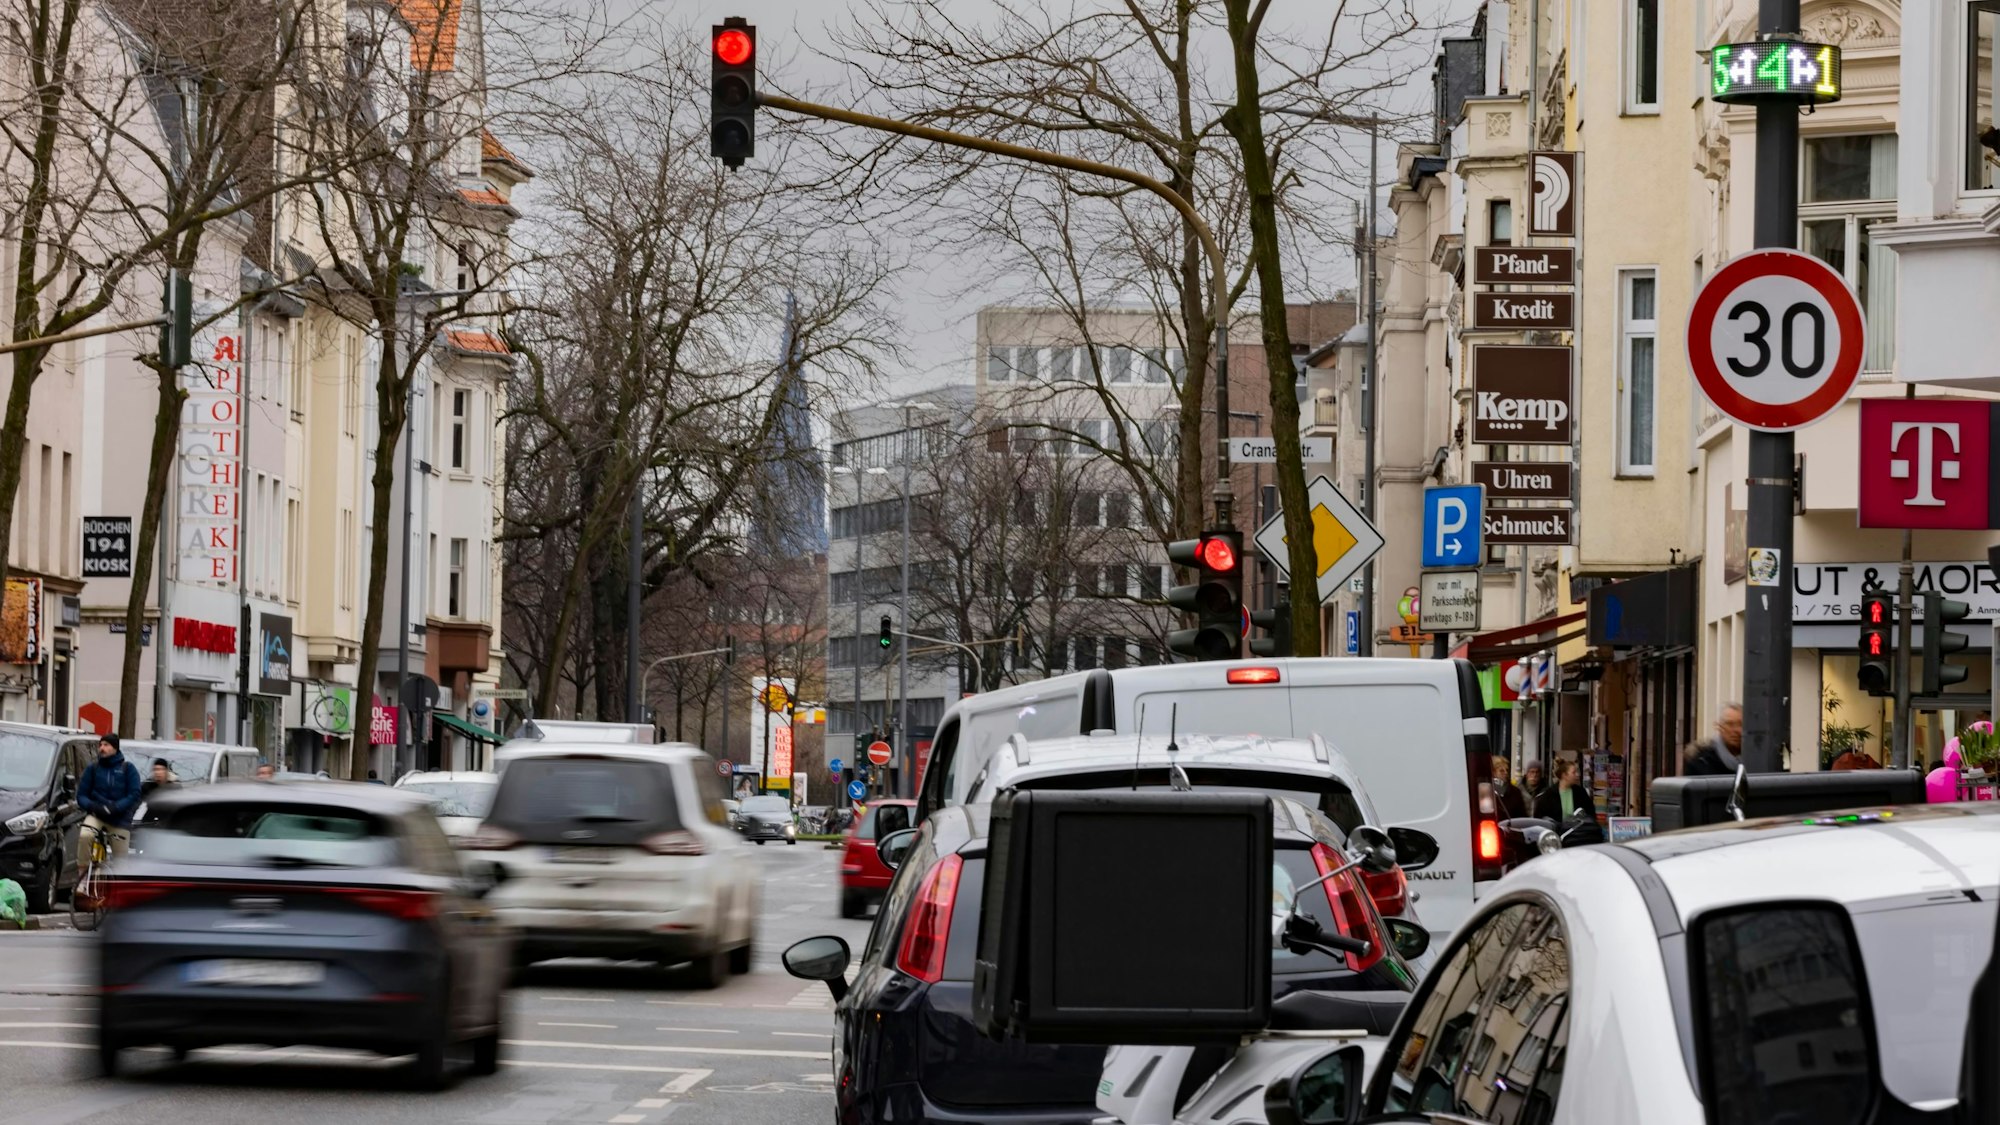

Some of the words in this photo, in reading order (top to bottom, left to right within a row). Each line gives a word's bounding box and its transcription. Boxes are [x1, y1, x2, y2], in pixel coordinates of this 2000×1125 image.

[1714, 47, 1730, 94] 5
[1757, 43, 1787, 91] 4
[1816, 46, 1836, 95] 1
[1492, 254, 1559, 274] Pfand-
[1493, 299, 1555, 319] Kredit
[1726, 300, 1825, 379] 30
[1477, 391, 1568, 430] Kemp
[210, 336, 236, 579] APOTHEKE
[1242, 441, 1314, 458] Cranatr.
[1890, 421, 1961, 507] T
[1491, 469, 1552, 490] Uhren
[83, 520, 131, 534] BÜDCHEN
[1436, 497, 1468, 557] P
[1483, 515, 1566, 536] Schmuck
[87, 537, 126, 552] 194
[84, 558, 129, 572] KIOSK
[1437, 582, 1448, 590] nur
[1451, 580, 1461, 589] mit
[1794, 566, 1848, 596] UT
[1861, 567, 1884, 595] &
[1432, 595, 1468, 606] Parkschein
[1823, 604, 1842, 615] 76
[1850, 604, 1860, 615] 8
[27, 581, 36, 658] KEBAP
[1423, 612, 1452, 625] werktags
[1400, 626, 1426, 636] EI
[371, 706, 390, 719] OL-
[370, 719, 393, 731] GNE
[370, 731, 395, 744] RINT
[1406, 871, 1456, 880] ENAULT
